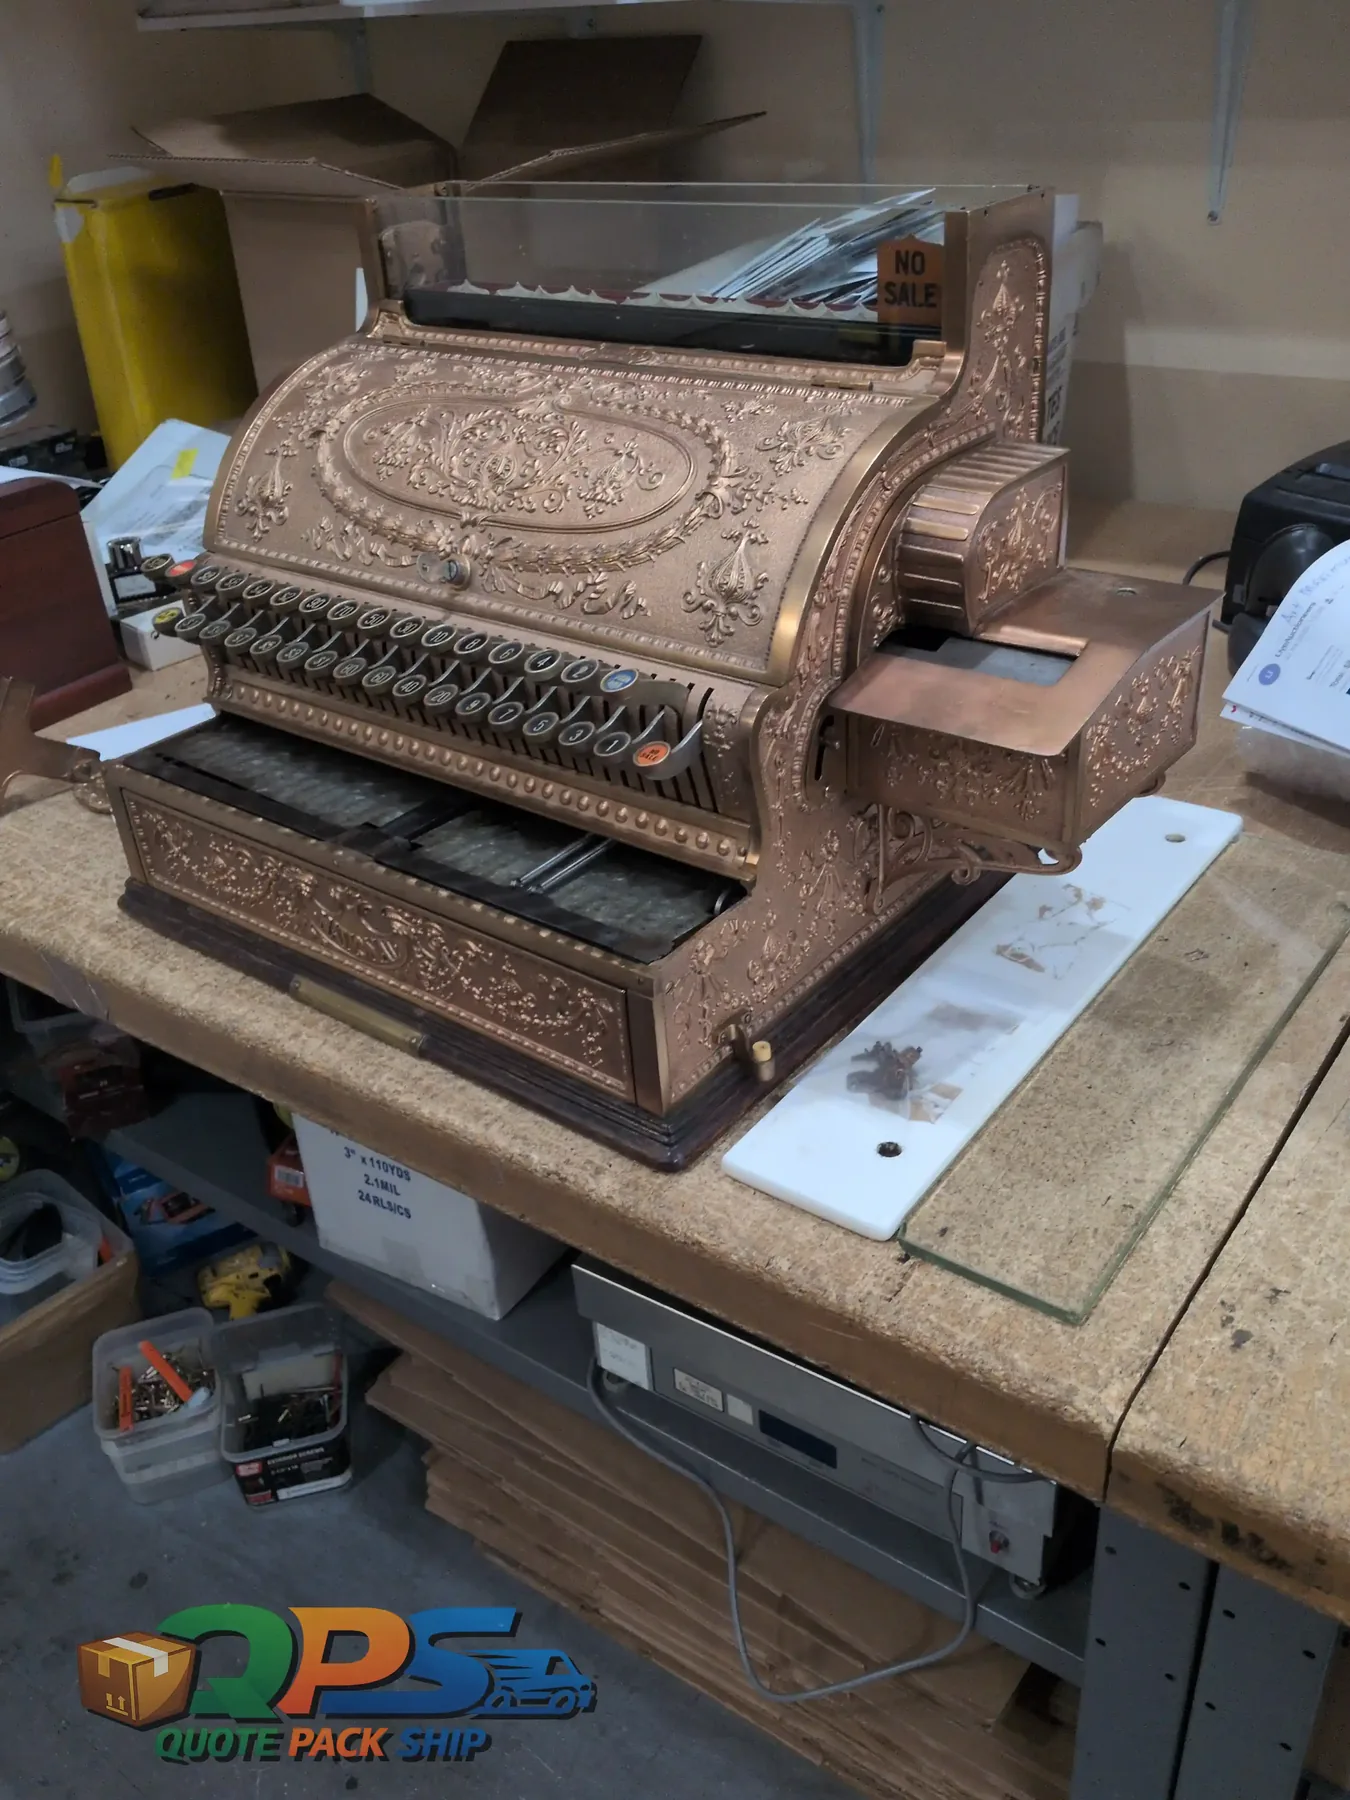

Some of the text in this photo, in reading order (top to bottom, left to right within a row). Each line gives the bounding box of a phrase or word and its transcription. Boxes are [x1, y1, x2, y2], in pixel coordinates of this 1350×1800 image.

[895, 250, 925, 276] NO
[884, 281, 938, 308] SALE
[306, 597, 327, 610] 90
[334, 605, 355, 618] 70
[364, 613, 386, 627] 50
[397, 621, 418, 634] 30
[430, 631, 449, 643] 10
[400, 680, 420, 693] 40
[430, 690, 452, 703] 20
[532, 719, 550, 732] 5
[568, 729, 585, 741] 3
[363, 1173, 400, 1196] 2.1MIL
